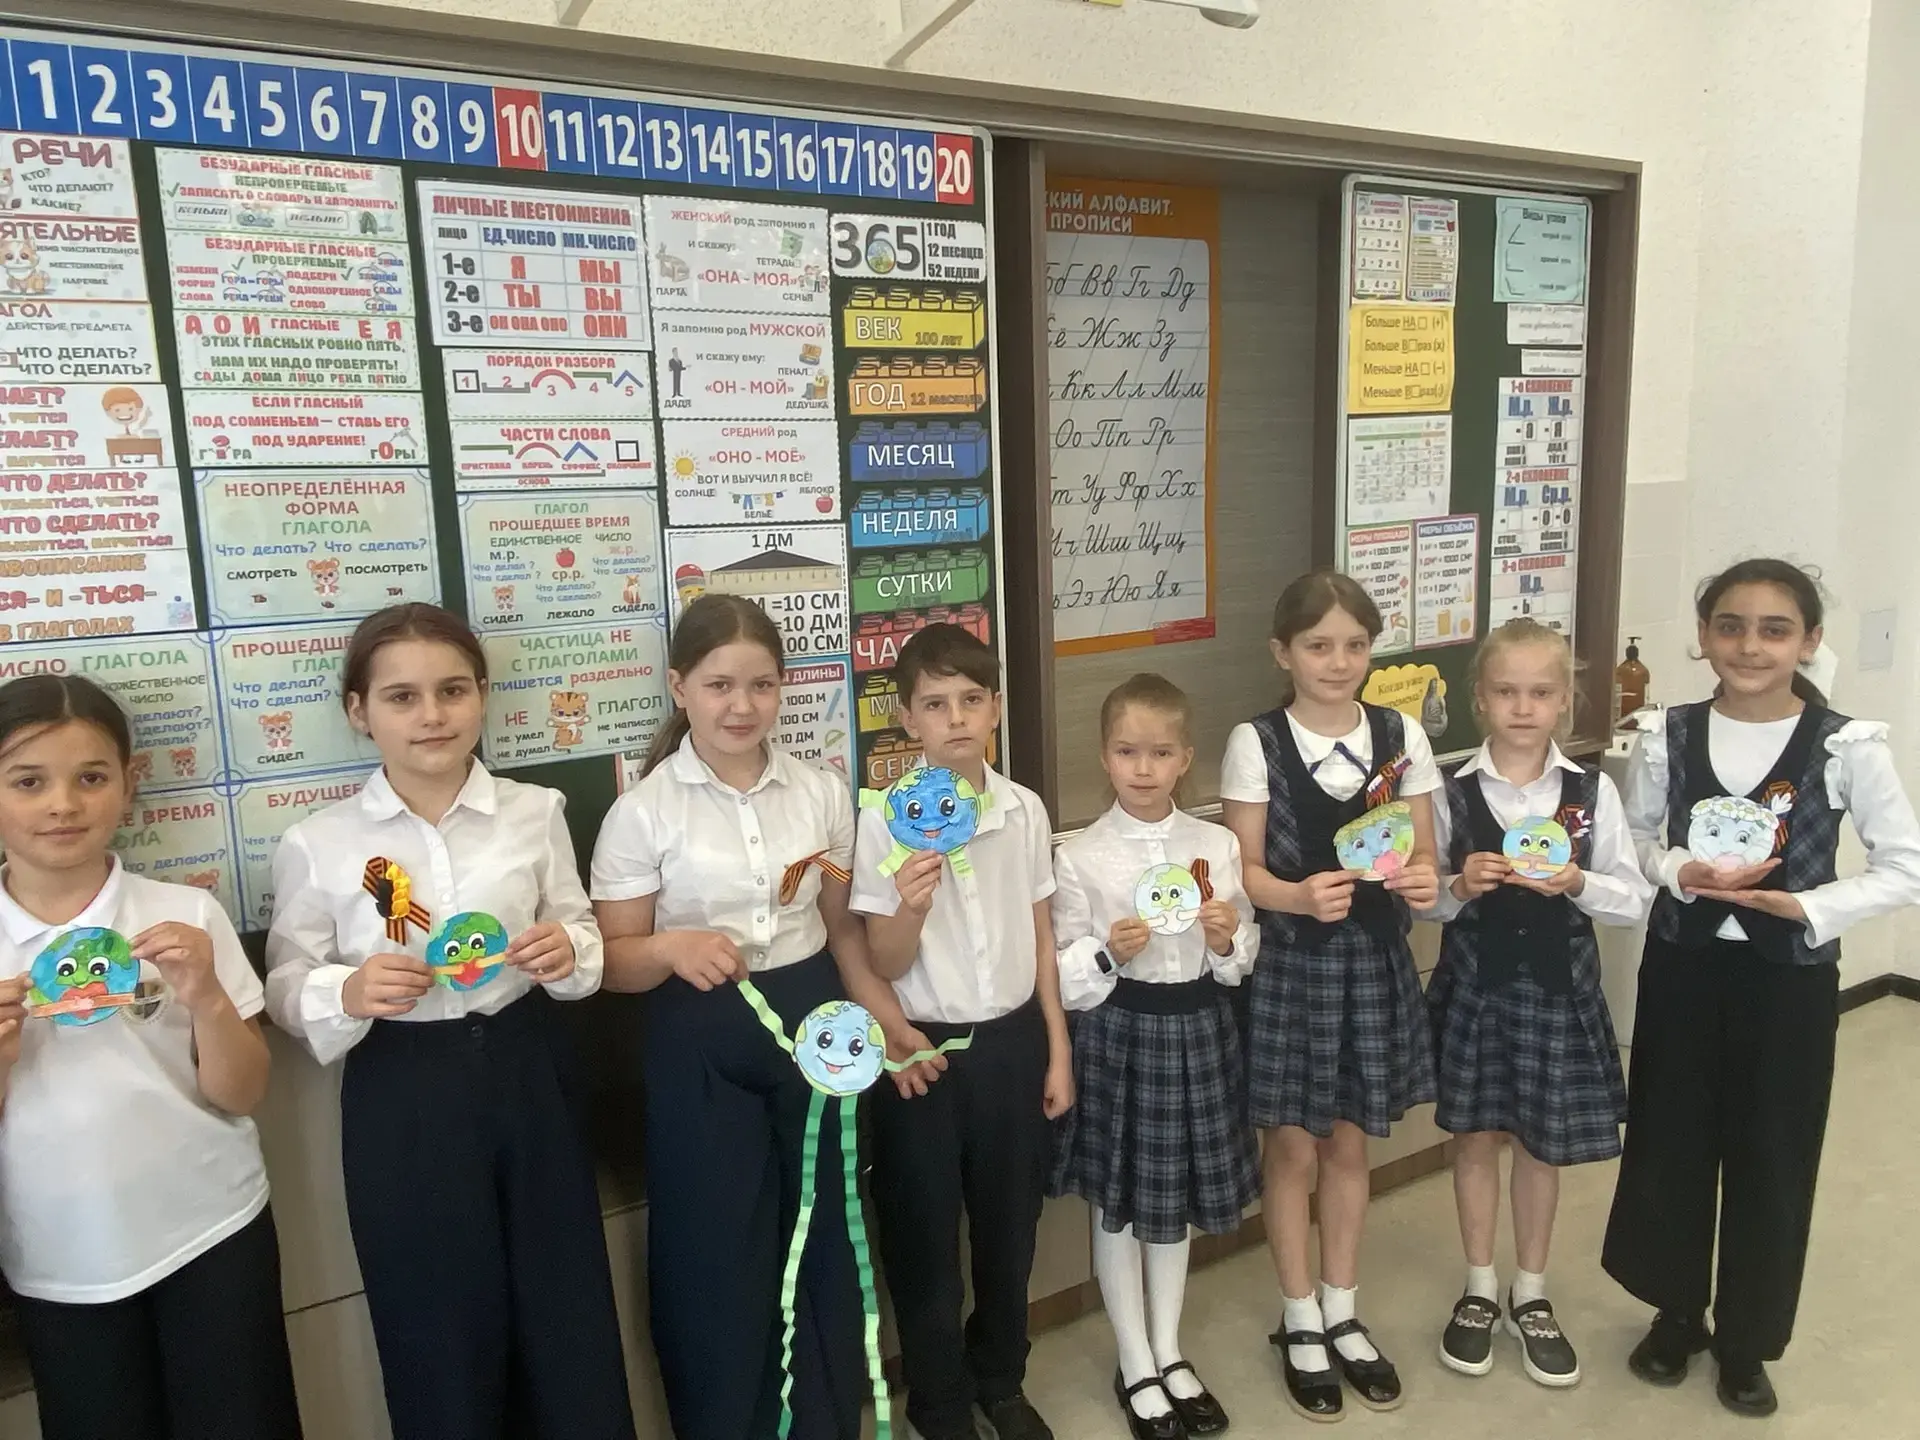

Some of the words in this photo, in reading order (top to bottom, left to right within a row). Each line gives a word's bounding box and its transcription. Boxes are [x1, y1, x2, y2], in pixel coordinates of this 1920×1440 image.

[28, 59, 58, 119] 1
[87, 64, 122, 124] 2
[145, 69, 177, 128] 3
[203, 75, 236, 133] 4
[259, 80, 285, 137] 5
[310, 86, 340, 141] 6
[360, 90, 386, 145] 7
[411, 95, 439, 150] 8
[459, 100, 486, 153] 9
[501, 104, 541, 158] 10
[548, 109, 586, 163] 11
[598, 114, 638, 167] 12
[645, 119, 684, 171] 13
[691, 124, 730, 174] 14
[736, 128, 772, 178] 15
[779, 132, 816, 182] 16
[821, 136, 854, 184] 17
[862, 140, 896, 188] 18
[901, 144, 933, 190] 19
[938, 148, 971, 194] 20
[12, 138, 112, 168] РЕЧИ
[21, 168, 51, 182] КТО?
[28, 184, 52, 192] ЧТО
[56, 183, 114, 193] ДЕЛАЮТ?
[31, 197, 82, 212] КАКИЕ?
[433, 195, 507, 218] ЛИЧНЫЕ
[511, 201, 631, 226] МЕСТОИМЕНИЯ
[1089, 195, 1174, 216] АЛФАВИТ.
[671, 210, 732, 224] ЖЕНСКИЙ
[1051, 213, 1133, 233] ПРОПИСИ
[483, 227, 556, 247] ЕД.ЧИСЛО
[562, 232, 636, 250] МН.ЧИСЛО
[927, 223, 933, 236] 1
[934, 224, 956, 239] ГОД
[205, 238, 306, 253] БЕЗУДАРНЫЕ
[309, 244, 377, 258] ГЛАСНЫЕ
[834, 222, 921, 274] 365
[928, 243, 939, 257] 12
[252, 254, 347, 269] ПРОВЕРЯЕМЫЕ
[442, 252, 475, 275] 1-е
[511, 256, 526, 279] Я
[579, 259, 621, 284] МЫ
[928, 264, 943, 277] 52
[944, 267, 979, 281] НЕДЕЛИ
[444, 280, 480, 303] 2-е
[503, 284, 540, 308] ТЫ
[585, 288, 622, 312] ВЫ
[72, 323, 132, 332] ПРЕДМЕТА
[185, 316, 203, 334] А
[214, 315, 231, 334] О
[243, 316, 260, 335] И
[271, 318, 340, 331] ГЛАСНЫЕ
[359, 321, 372, 339] Е
[386, 321, 402, 340] Я
[447, 311, 483, 333] 3-е
[583, 315, 627, 338] ОНИ
[856, 317, 902, 340] ВЕК
[1366, 316, 1401, 328] Больше
[1403, 316, 1416, 328] НА
[672, 325, 723, 334] запомню
[727, 327, 747, 336] род
[750, 323, 826, 338] МУЖСКОЙ
[202, 336, 239, 348] ЭТИХ
[243, 337, 313, 350] ГЛАСНЫХ
[318, 339, 362, 351] РОВНО
[1365, 339, 1399, 351] Больше
[17, 347, 52, 358] ЧТО
[58, 347, 137, 360] ДЕЛАТЬ?
[19, 363, 54, 375] ЧТО
[60, 363, 152, 377] СДЕЛАТЬ?
[211, 356, 244, 367] НАМ
[249, 356, 267, 368] ИХ
[271, 356, 311, 368] НАДО
[316, 358, 398, 370] ПРОВЕРЯТЬ!
[487, 355, 552, 369] ПОРЯДОК
[556, 357, 616, 368] РАЗБОРА
[1364, 363, 1402, 375] Меньше
[1405, 363, 1418, 374] НА
[462, 377, 469, 388] 1
[502, 376, 513, 387] 2
[548, 386, 556, 396] 3
[589, 382, 599, 393] 4
[625, 386, 634, 397] 5
[252, 396, 290, 407] ЕСЛИ
[294, 395, 363, 409] ГЛАСНЫЙ
[854, 383, 906, 410] ГОД
[786, 401, 829, 409] ДЕДУШКА
[193, 416, 225, 429] ПОД
[229, 416, 319, 427] СОМНЕНЬЕМ
[338, 417, 381, 427] СТАВЬ
[385, 417, 409, 427] ЕГО
[501, 428, 554, 440] ЧАСТИ
[558, 428, 611, 440] СЛОВА
[722, 426, 775, 438] СРЕДНИЙ
[778, 430, 797, 438] род
[252, 435, 283, 448] ПОД
[287, 435, 365, 447] УДАРЕНИЕ!
[868, 444, 954, 468] МЕСЯЦ
[698, 475, 719, 484] ВОТ
[722, 475, 729, 483] И
[732, 474, 777, 483] ВЫУЧИЛ
[225, 479, 405, 499] НЕОПРЕДЕЛЁННАЯ
[675, 488, 716, 498] СОЛНЦЕ
[285, 501, 359, 516] ФОРМА
[534, 503, 589, 515] ГЛАГОЛ
[47, 513, 159, 535] СДЕЛАТЬ?
[282, 520, 372, 535] ГЛАГОЛА
[490, 518, 581, 531] ПРОШЕДШЕЕ
[586, 516, 630, 528] ВРЕМЯ
[862, 509, 957, 537] НЕДЕЛЯ
[216, 544, 245, 556] Что
[253, 542, 316, 556] делать?
[324, 540, 352, 552] Что
[360, 538, 427, 552] сделать?
[490, 534, 582, 547] ЕДИНСТВЕННОЕ
[595, 533, 631, 543] ЧИСЛО
[752, 534, 760, 547] 1
[765, 533, 792, 550] ДМ
[227, 568, 297, 581] смотреть
[345, 564, 428, 576] посмотреть
[877, 571, 952, 598] СУТКИ
[811, 593, 840, 609] СМ
[483, 613, 524, 624] сидел
[547, 609, 595, 620] лежало
[612, 603, 655, 613] сидела
[17, 616, 134, 639] ГЛАГОЛАХ
[520, 632, 604, 651] ЧАСТИЦА
[610, 630, 632, 643] НЕ
[82, 650, 188, 673] ГЛАГОЛА
[512, 659, 522, 672] С
[528, 648, 638, 671] ГЛАГОЛАМИ
[491, 675, 562, 692] пишется
[570, 666, 653, 687] раздельно
[793, 668, 841, 684] ДЛИНЫ
[233, 683, 261, 693] Что
[269, 676, 325, 692] делал?
[129, 693, 173, 704] ЧИСЛО
[231, 698, 259, 709] Что
[267, 690, 331, 706] сделал?
[787, 694, 812, 705] 1000
[817, 693, 826, 702] М
[505, 711, 528, 727] НЕ
[597, 696, 662, 715] ГЛАГОЛ
[258, 752, 304, 764] сидел
[154, 849, 226, 871] делают?
